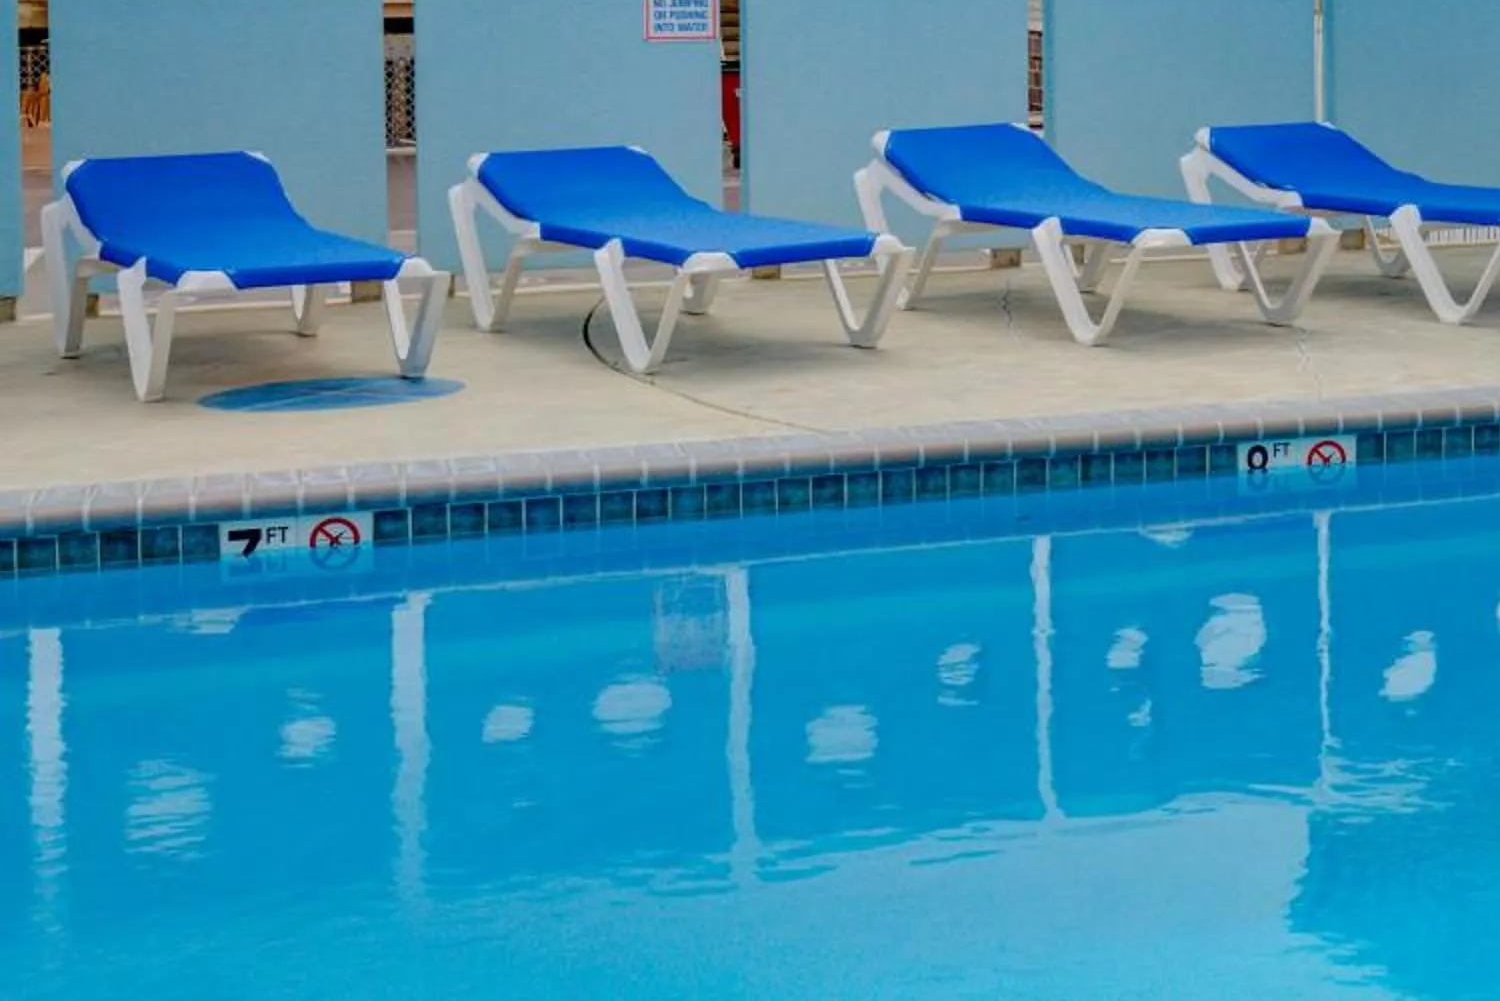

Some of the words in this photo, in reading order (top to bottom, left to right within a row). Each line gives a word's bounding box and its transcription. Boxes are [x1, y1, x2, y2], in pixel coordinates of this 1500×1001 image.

[653, 10, 667, 20] OR
[670, 10, 707, 20] PUSHING
[654, 22, 675, 32] INTO
[678, 22, 708, 32] WATER
[1273, 442, 1290, 458] FT
[228, 528, 262, 558] 7
[266, 526, 289, 544] FT
